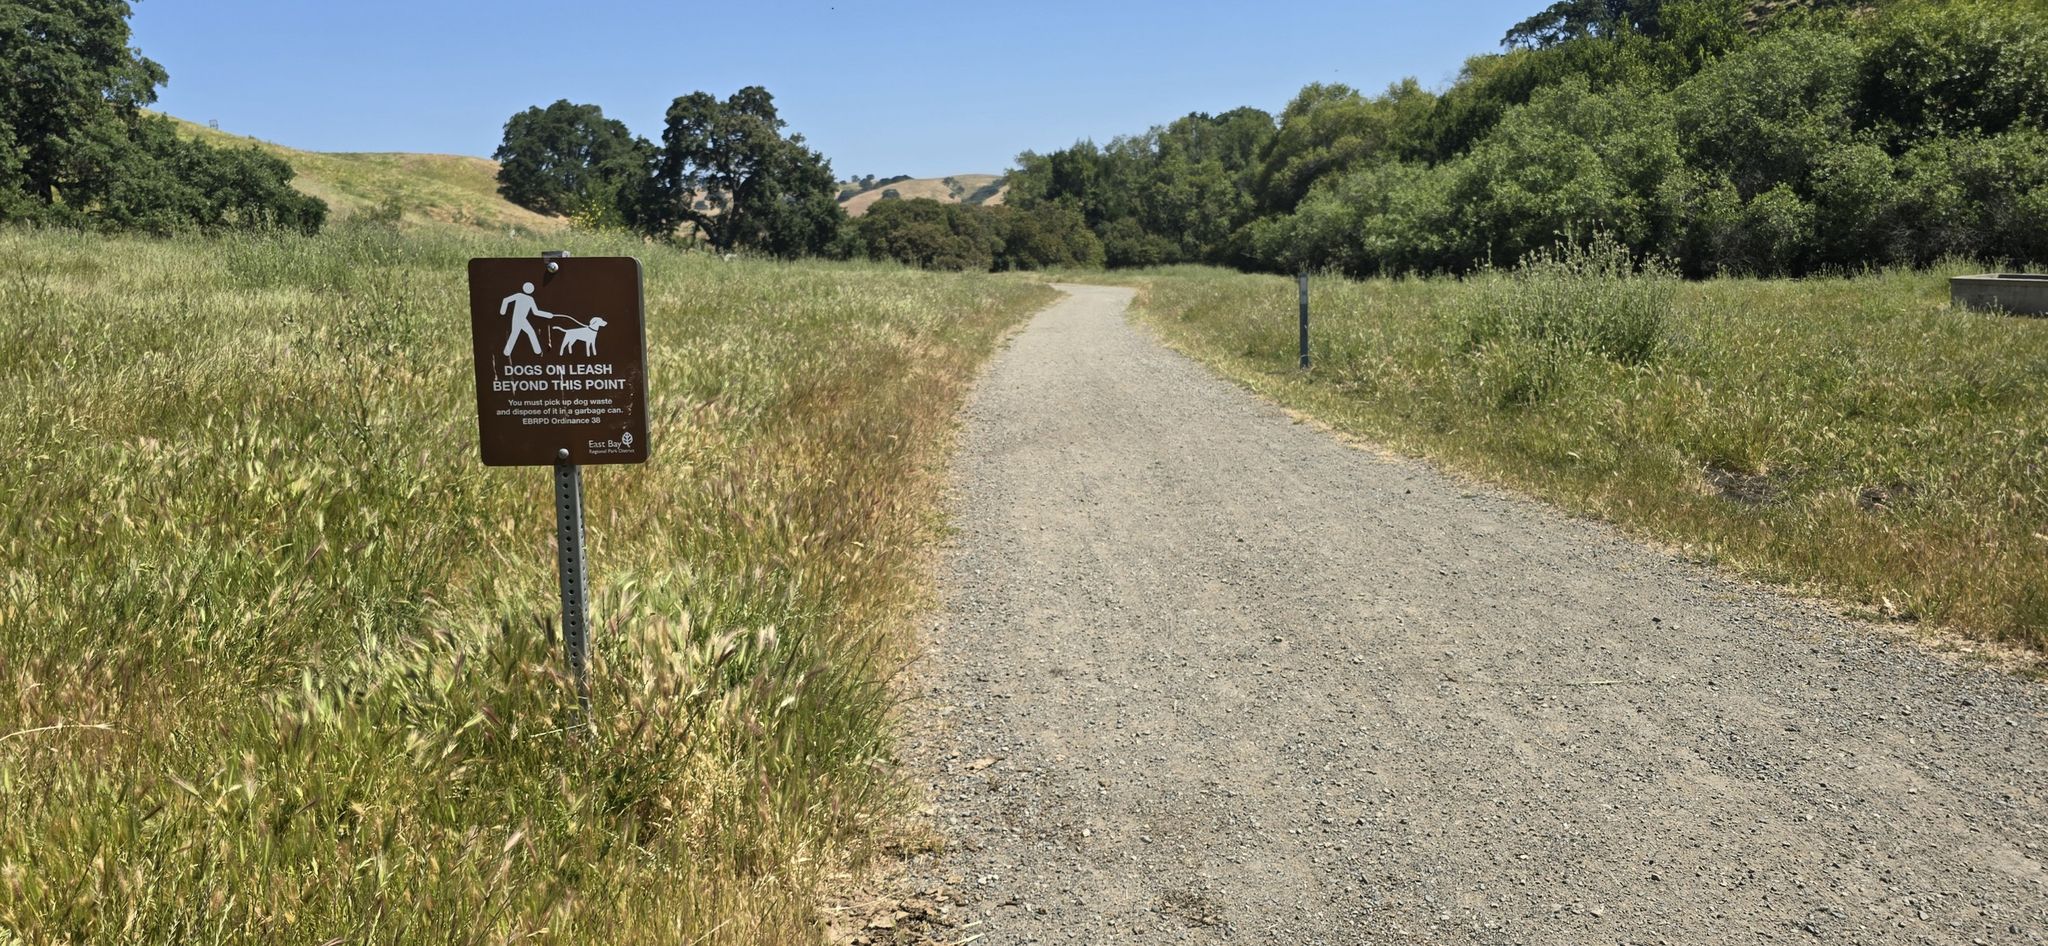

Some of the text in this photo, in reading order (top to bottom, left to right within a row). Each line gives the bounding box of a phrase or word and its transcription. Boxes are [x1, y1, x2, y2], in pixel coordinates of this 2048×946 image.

[504, 364, 613, 376] DOGS ON LEASH
[492, 379, 626, 391] BEYOND THIS POINT
[544, 399, 560, 407] pick
[562, 399, 572, 407] up
[573, 398, 588, 406] dog
[512, 408, 542, 416] dispose
[574, 408, 606, 416] garbage
[588, 440, 622, 449] East Bay
